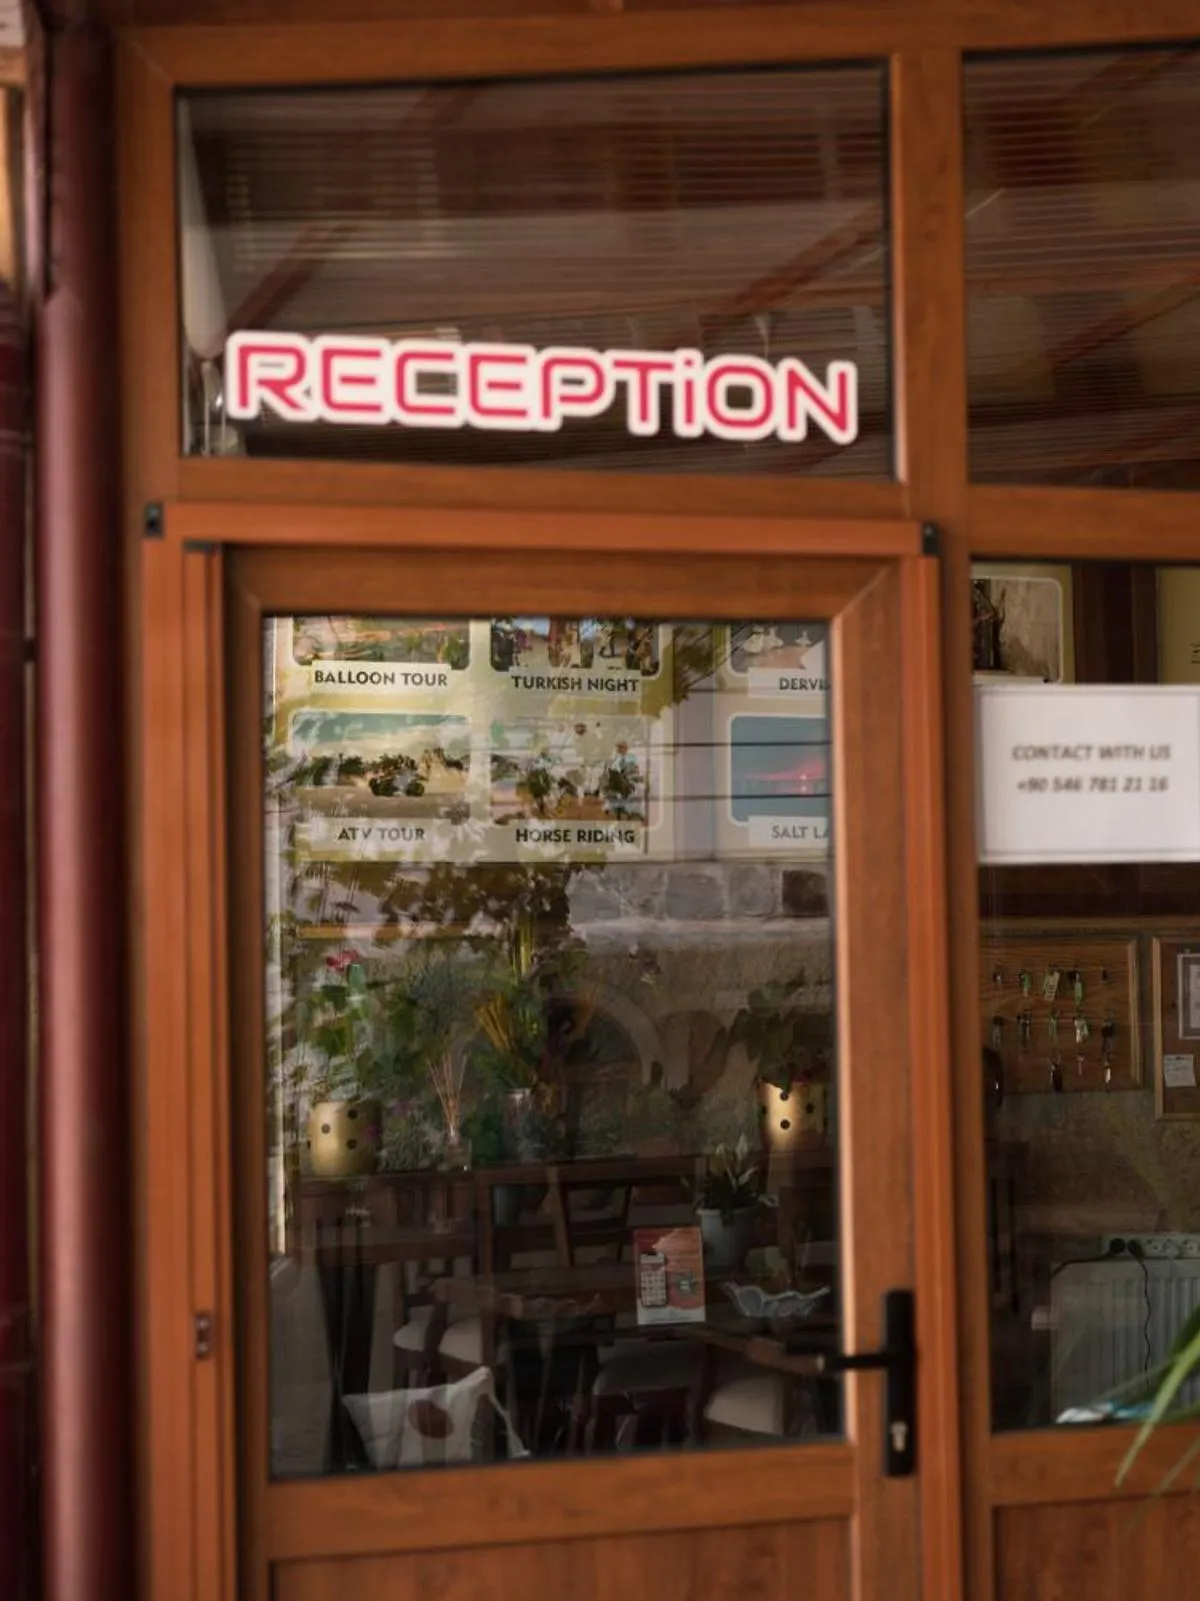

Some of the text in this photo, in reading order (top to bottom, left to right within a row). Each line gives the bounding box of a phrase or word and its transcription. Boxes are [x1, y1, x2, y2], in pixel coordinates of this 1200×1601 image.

[314, 670, 448, 687] BALLOON TOUR
[511, 675, 639, 692] TURKISH NIGHT
[1011, 743, 1172, 761] CONTACT WITH US
[1016, 776, 1049, 793] +90
[337, 827, 425, 842] ATV TOUR
[514, 828, 636, 844] HORSE RIDING
[770, 824, 810, 840] SALT
